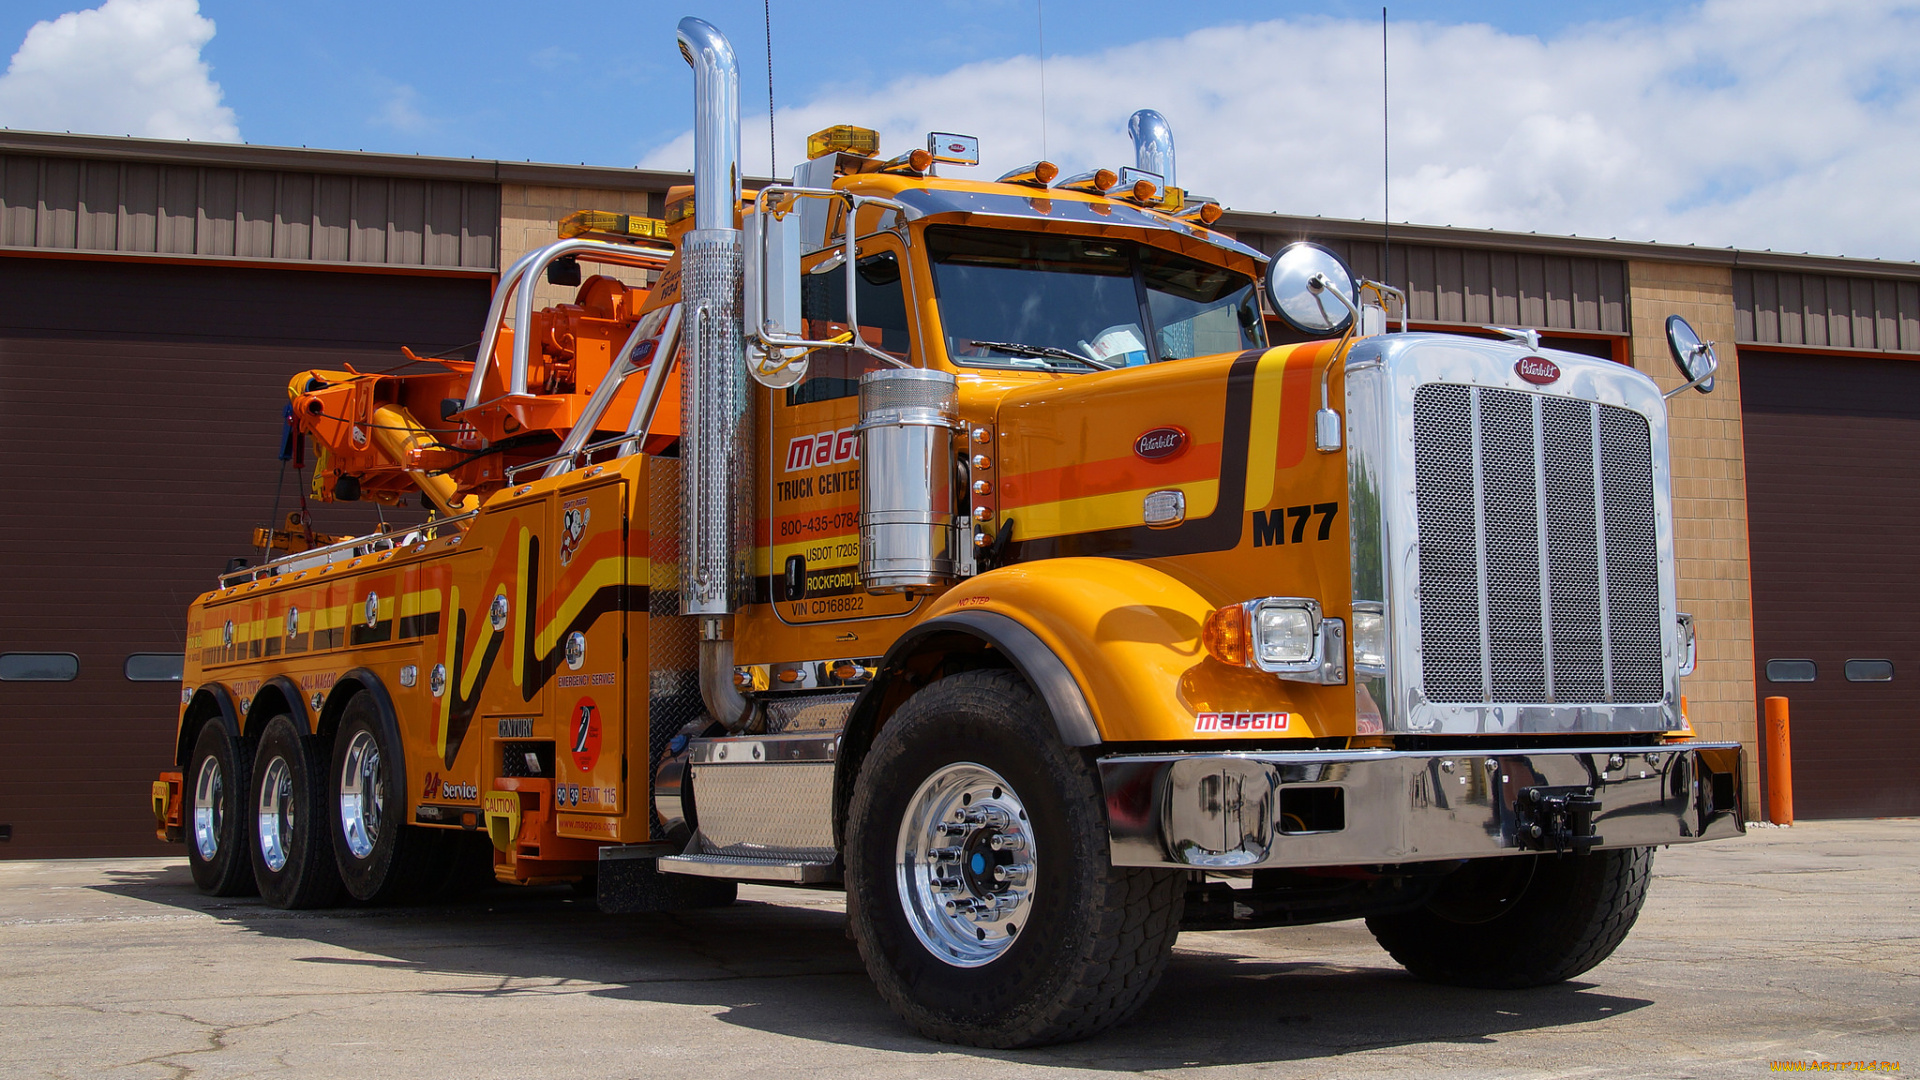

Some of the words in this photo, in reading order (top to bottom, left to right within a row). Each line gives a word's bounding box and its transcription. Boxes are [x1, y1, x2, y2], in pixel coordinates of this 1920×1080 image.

[1520, 359, 1557, 378] Peterbilt
[1140, 434, 1178, 453] Peterbilt
[777, 477, 813, 502] TRUCK
[781, 511, 860, 536] 800-435-0784
[1252, 501, 1339, 548] M77
[806, 546, 833, 562] USDOT
[807, 573, 854, 592] ROCKFORD,
[792, 602, 807, 616] VIN
[811, 597, 863, 614] CD168822
[957, 597, 969, 607] NO
[970, 596, 990, 605] STEP
[558, 674, 590, 687] EMERGENCY
[592, 672, 615, 686] SERVICE
[498, 718, 534, 738] CENTURY
[443, 781, 477, 800] Service
[557, 788, 566, 801] 90
[570, 788, 579, 802] 39
[581, 786, 600, 803] EXIT
[603, 787, 616, 804] 115
[485, 798, 516, 814] CAUTION
[559, 820, 617, 832] www.maggios.com
